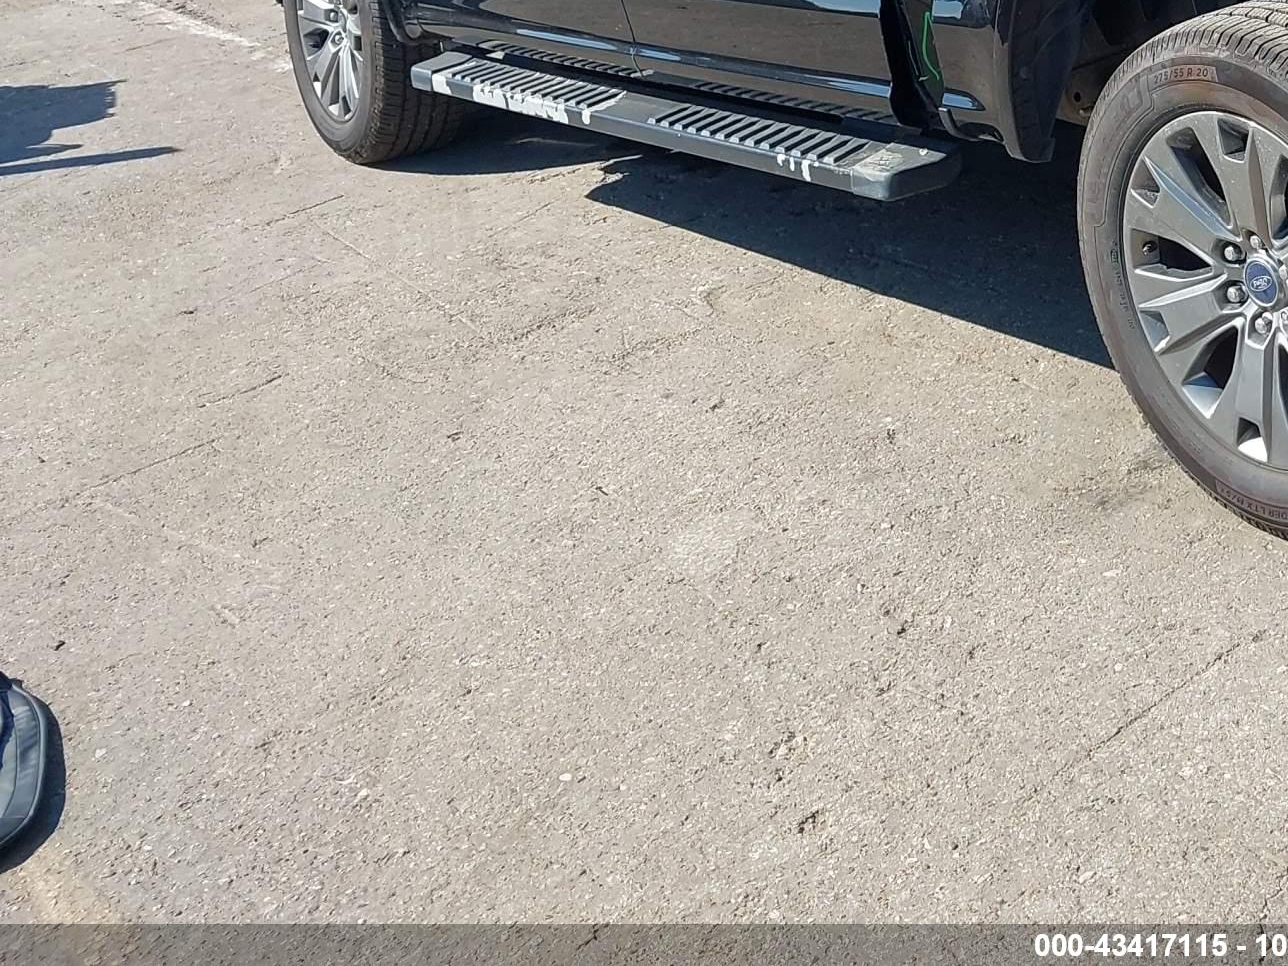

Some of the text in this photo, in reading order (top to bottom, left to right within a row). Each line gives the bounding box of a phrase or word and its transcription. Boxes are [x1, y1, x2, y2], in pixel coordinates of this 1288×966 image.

[1153, 67, 1209, 85] 275/55 R 20
